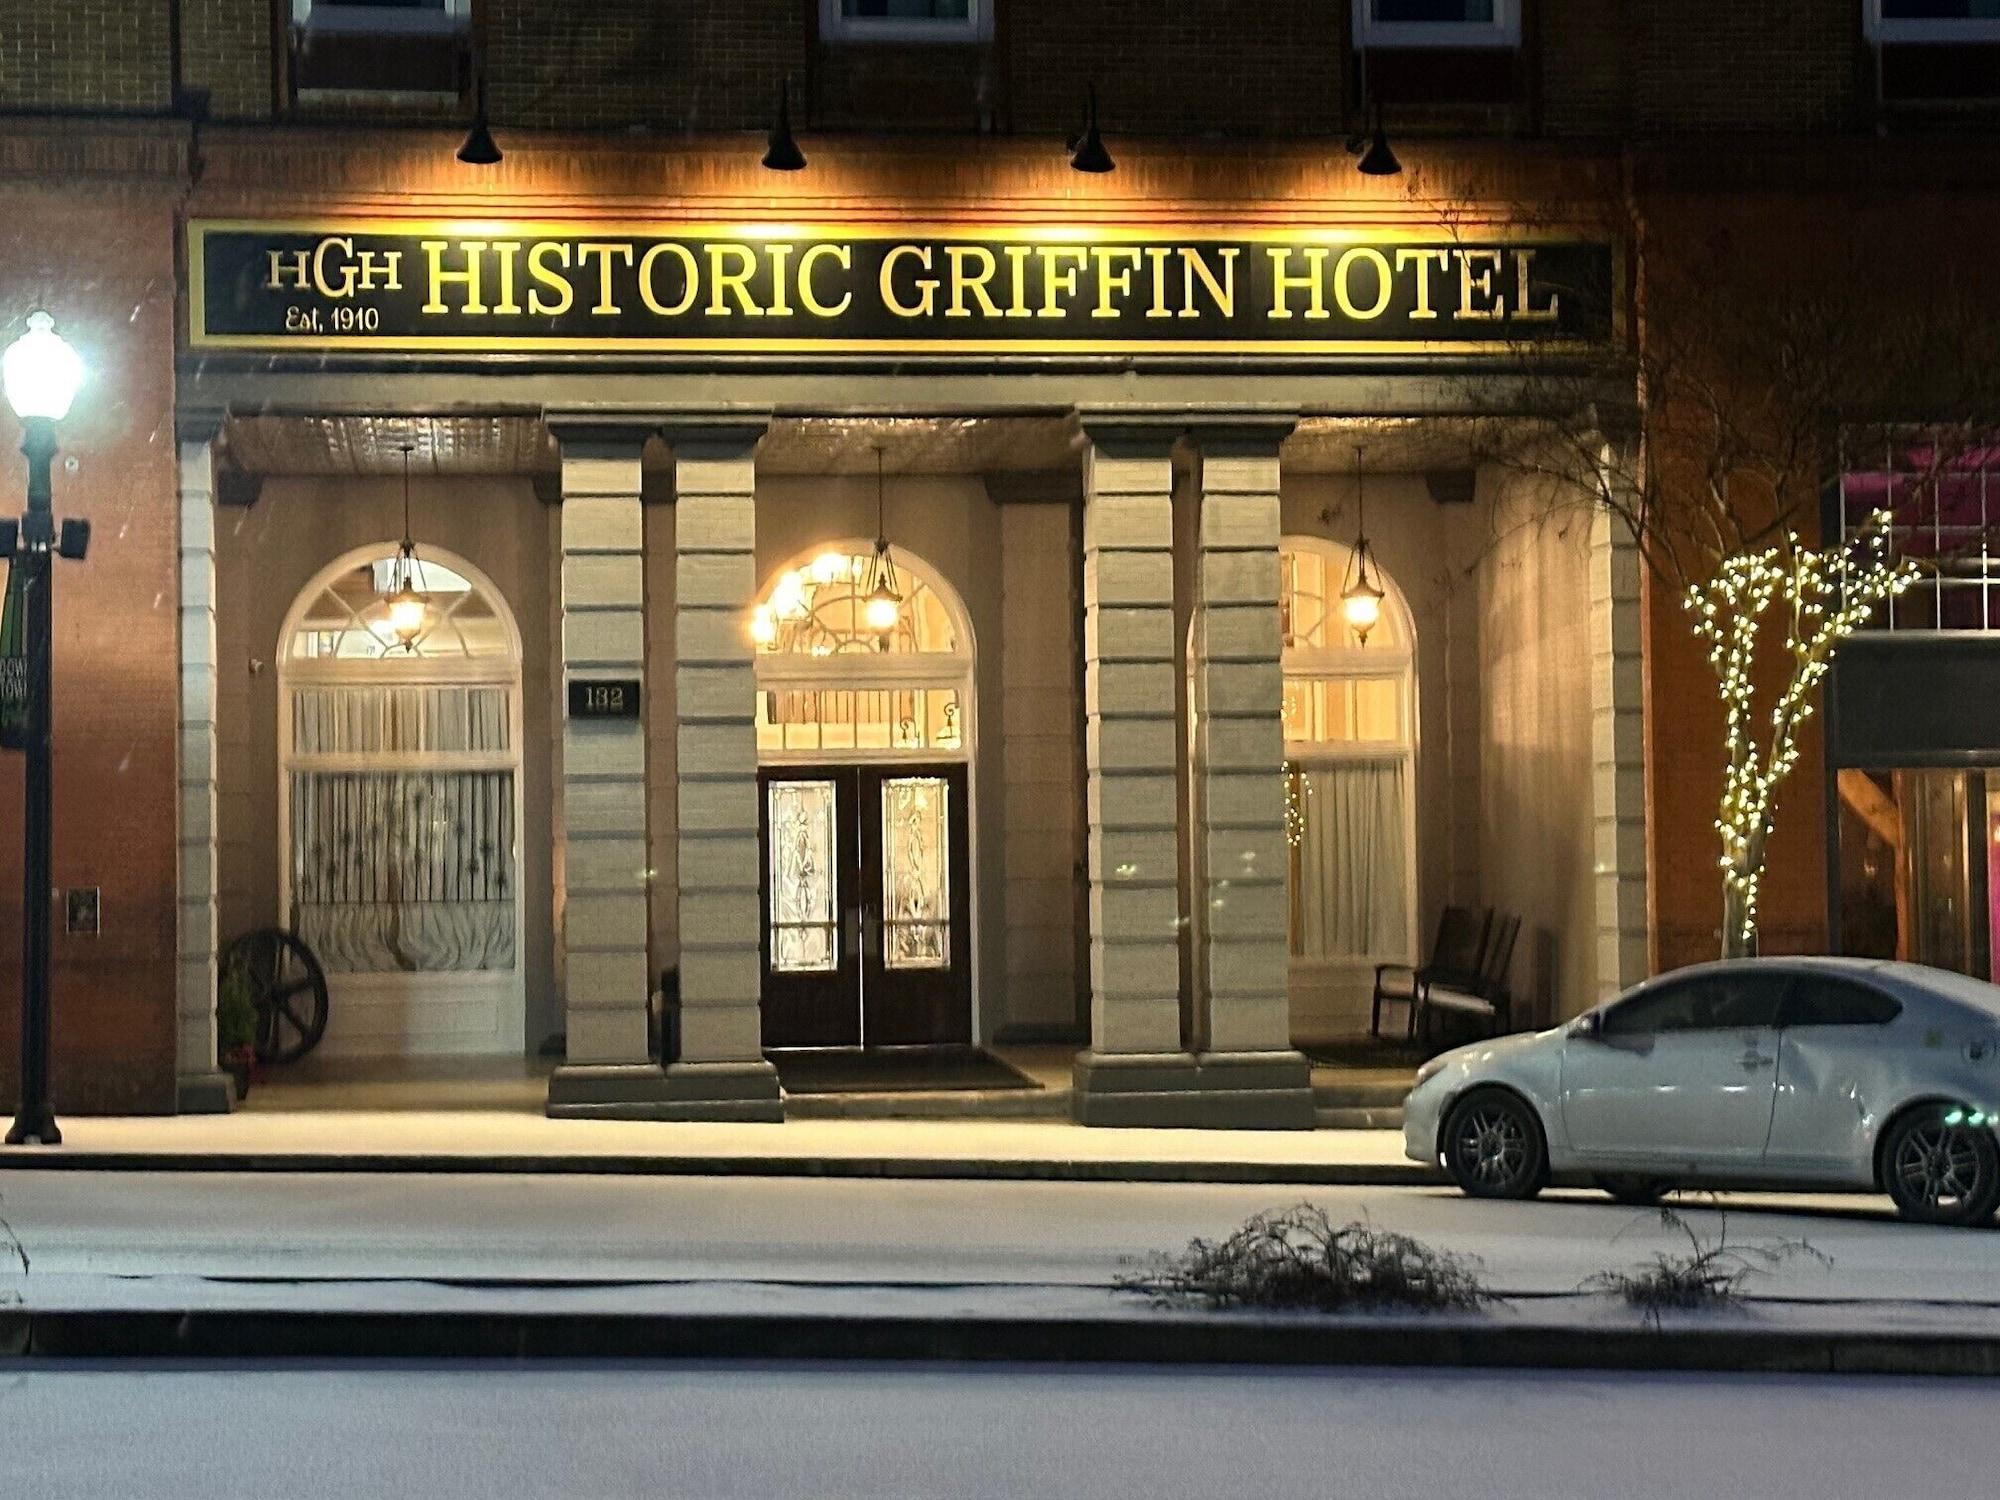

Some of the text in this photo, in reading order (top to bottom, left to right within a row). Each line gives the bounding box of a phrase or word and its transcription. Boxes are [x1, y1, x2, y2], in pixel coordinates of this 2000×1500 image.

[266, 237, 403, 297] HGH
[420, 240, 1559, 320] HISTORIC GRIFFIN HOTEL
[330, 306, 380, 331] 1910
